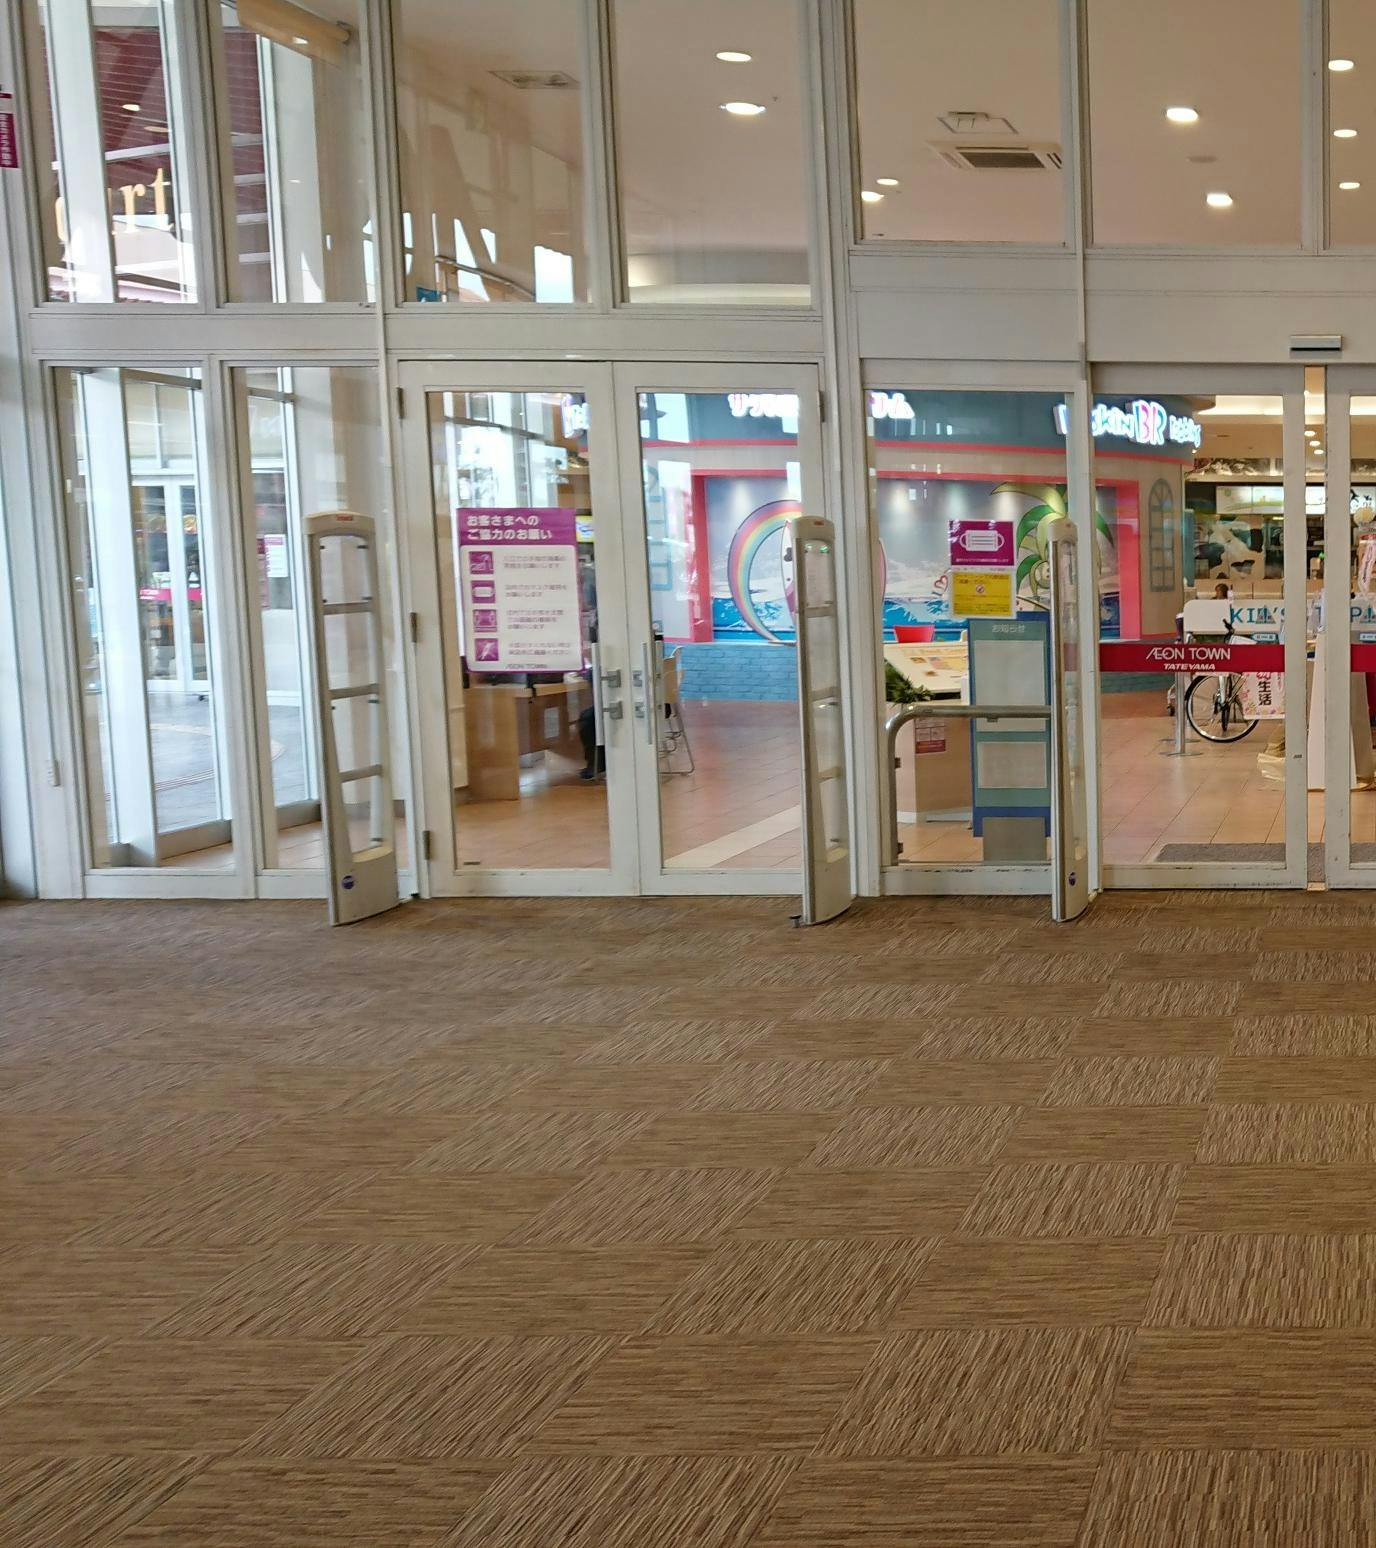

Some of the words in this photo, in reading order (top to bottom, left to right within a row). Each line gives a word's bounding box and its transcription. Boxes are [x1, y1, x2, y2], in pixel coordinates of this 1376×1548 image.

[467, 516, 539, 526] お客さまへの
[467, 529, 552, 540] ご協力のお願い
[1189, 648, 1231, 660] TOWN
